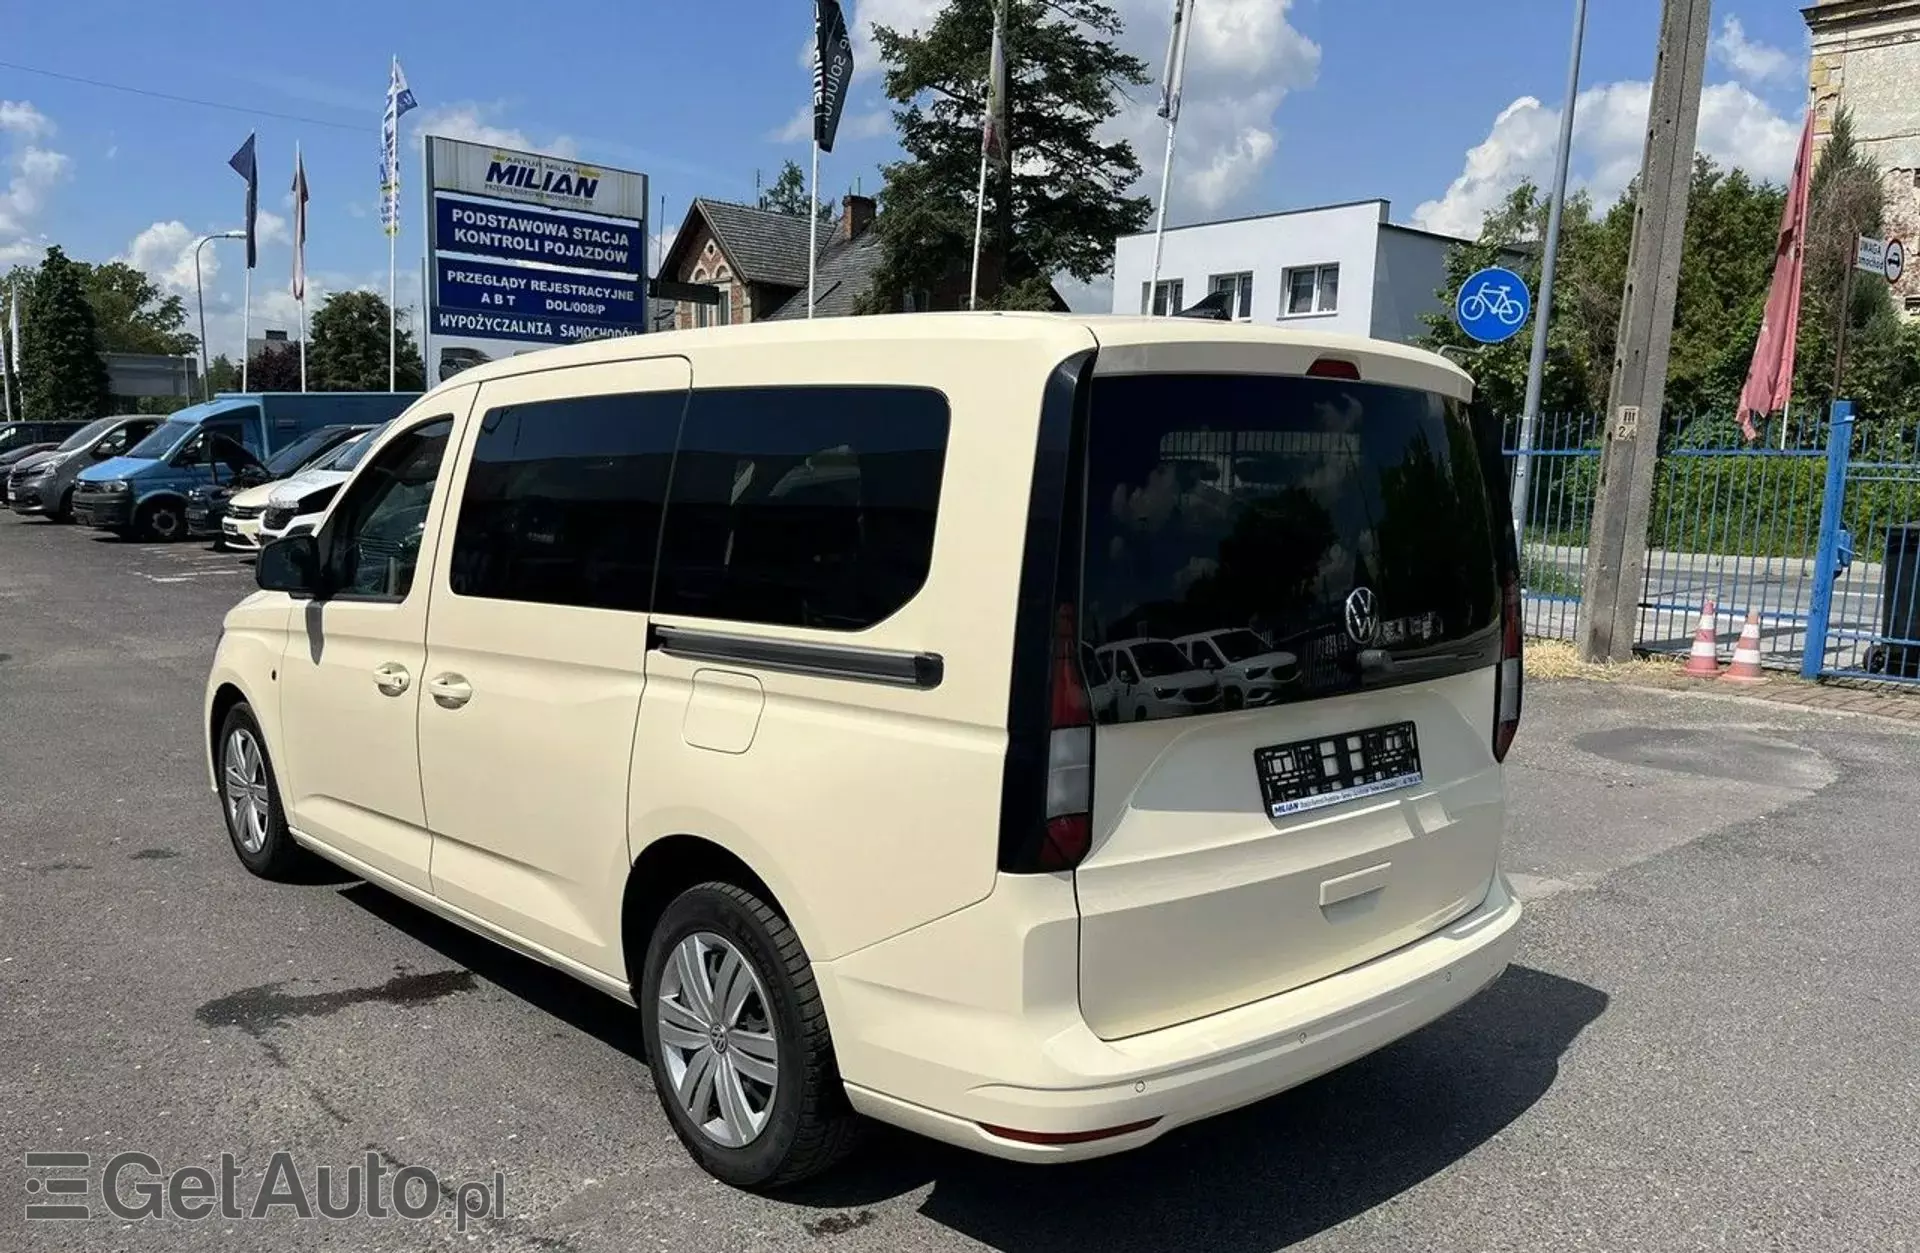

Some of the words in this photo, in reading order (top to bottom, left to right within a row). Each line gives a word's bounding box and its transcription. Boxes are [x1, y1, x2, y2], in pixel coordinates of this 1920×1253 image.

[485, 161, 600, 198] MILIAN
[452, 208, 568, 239] PODSTAWOWA
[572, 228, 629, 247] STACJA
[454, 228, 540, 252] KONTROLI
[544, 241, 629, 264] POJAZDÓW
[447, 270, 527, 291] PRZEGLĄDY
[530, 279, 635, 301] REJESTRACYJNE
[481, 292, 491, 304] A
[494, 294, 504, 305] B
[506, 295, 516, 307] T
[545, 299, 606, 316] DOL/008/P
[439, 313, 553, 336] WYPOŻYCZALNIA
